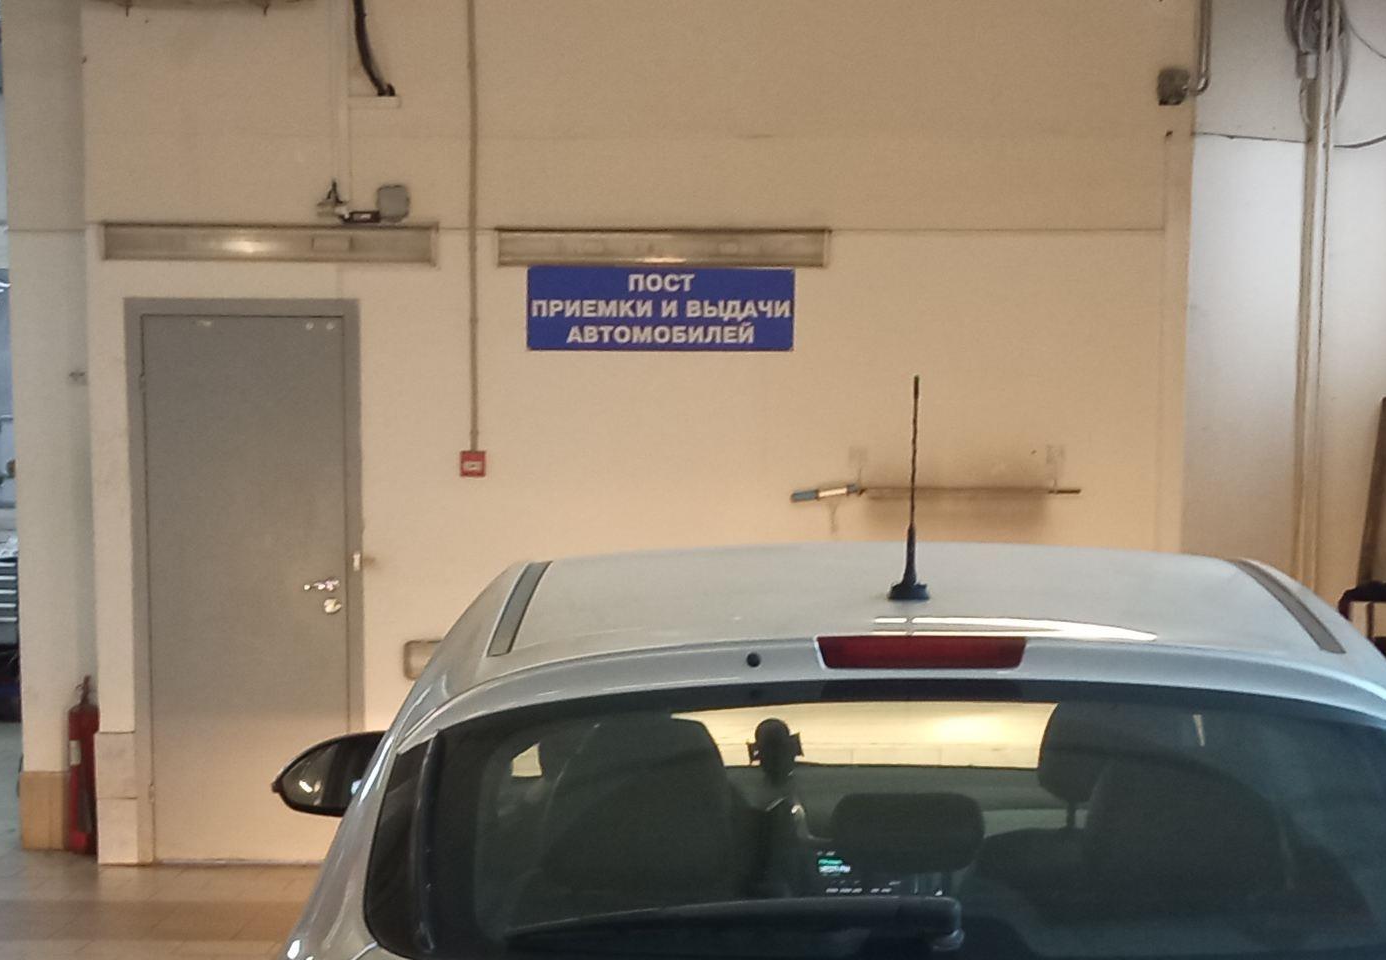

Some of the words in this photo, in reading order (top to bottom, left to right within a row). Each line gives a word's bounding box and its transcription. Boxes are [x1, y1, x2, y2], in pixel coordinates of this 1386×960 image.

[628, 273, 695, 292] ПОСТ
[531, 299, 653, 318] ПРИЕМКИ
[661, 299, 679, 318] И
[685, 299, 791, 322] ВЫДАЧИ
[566, 321, 755, 345] АВТОМОБИЛЕЙ
